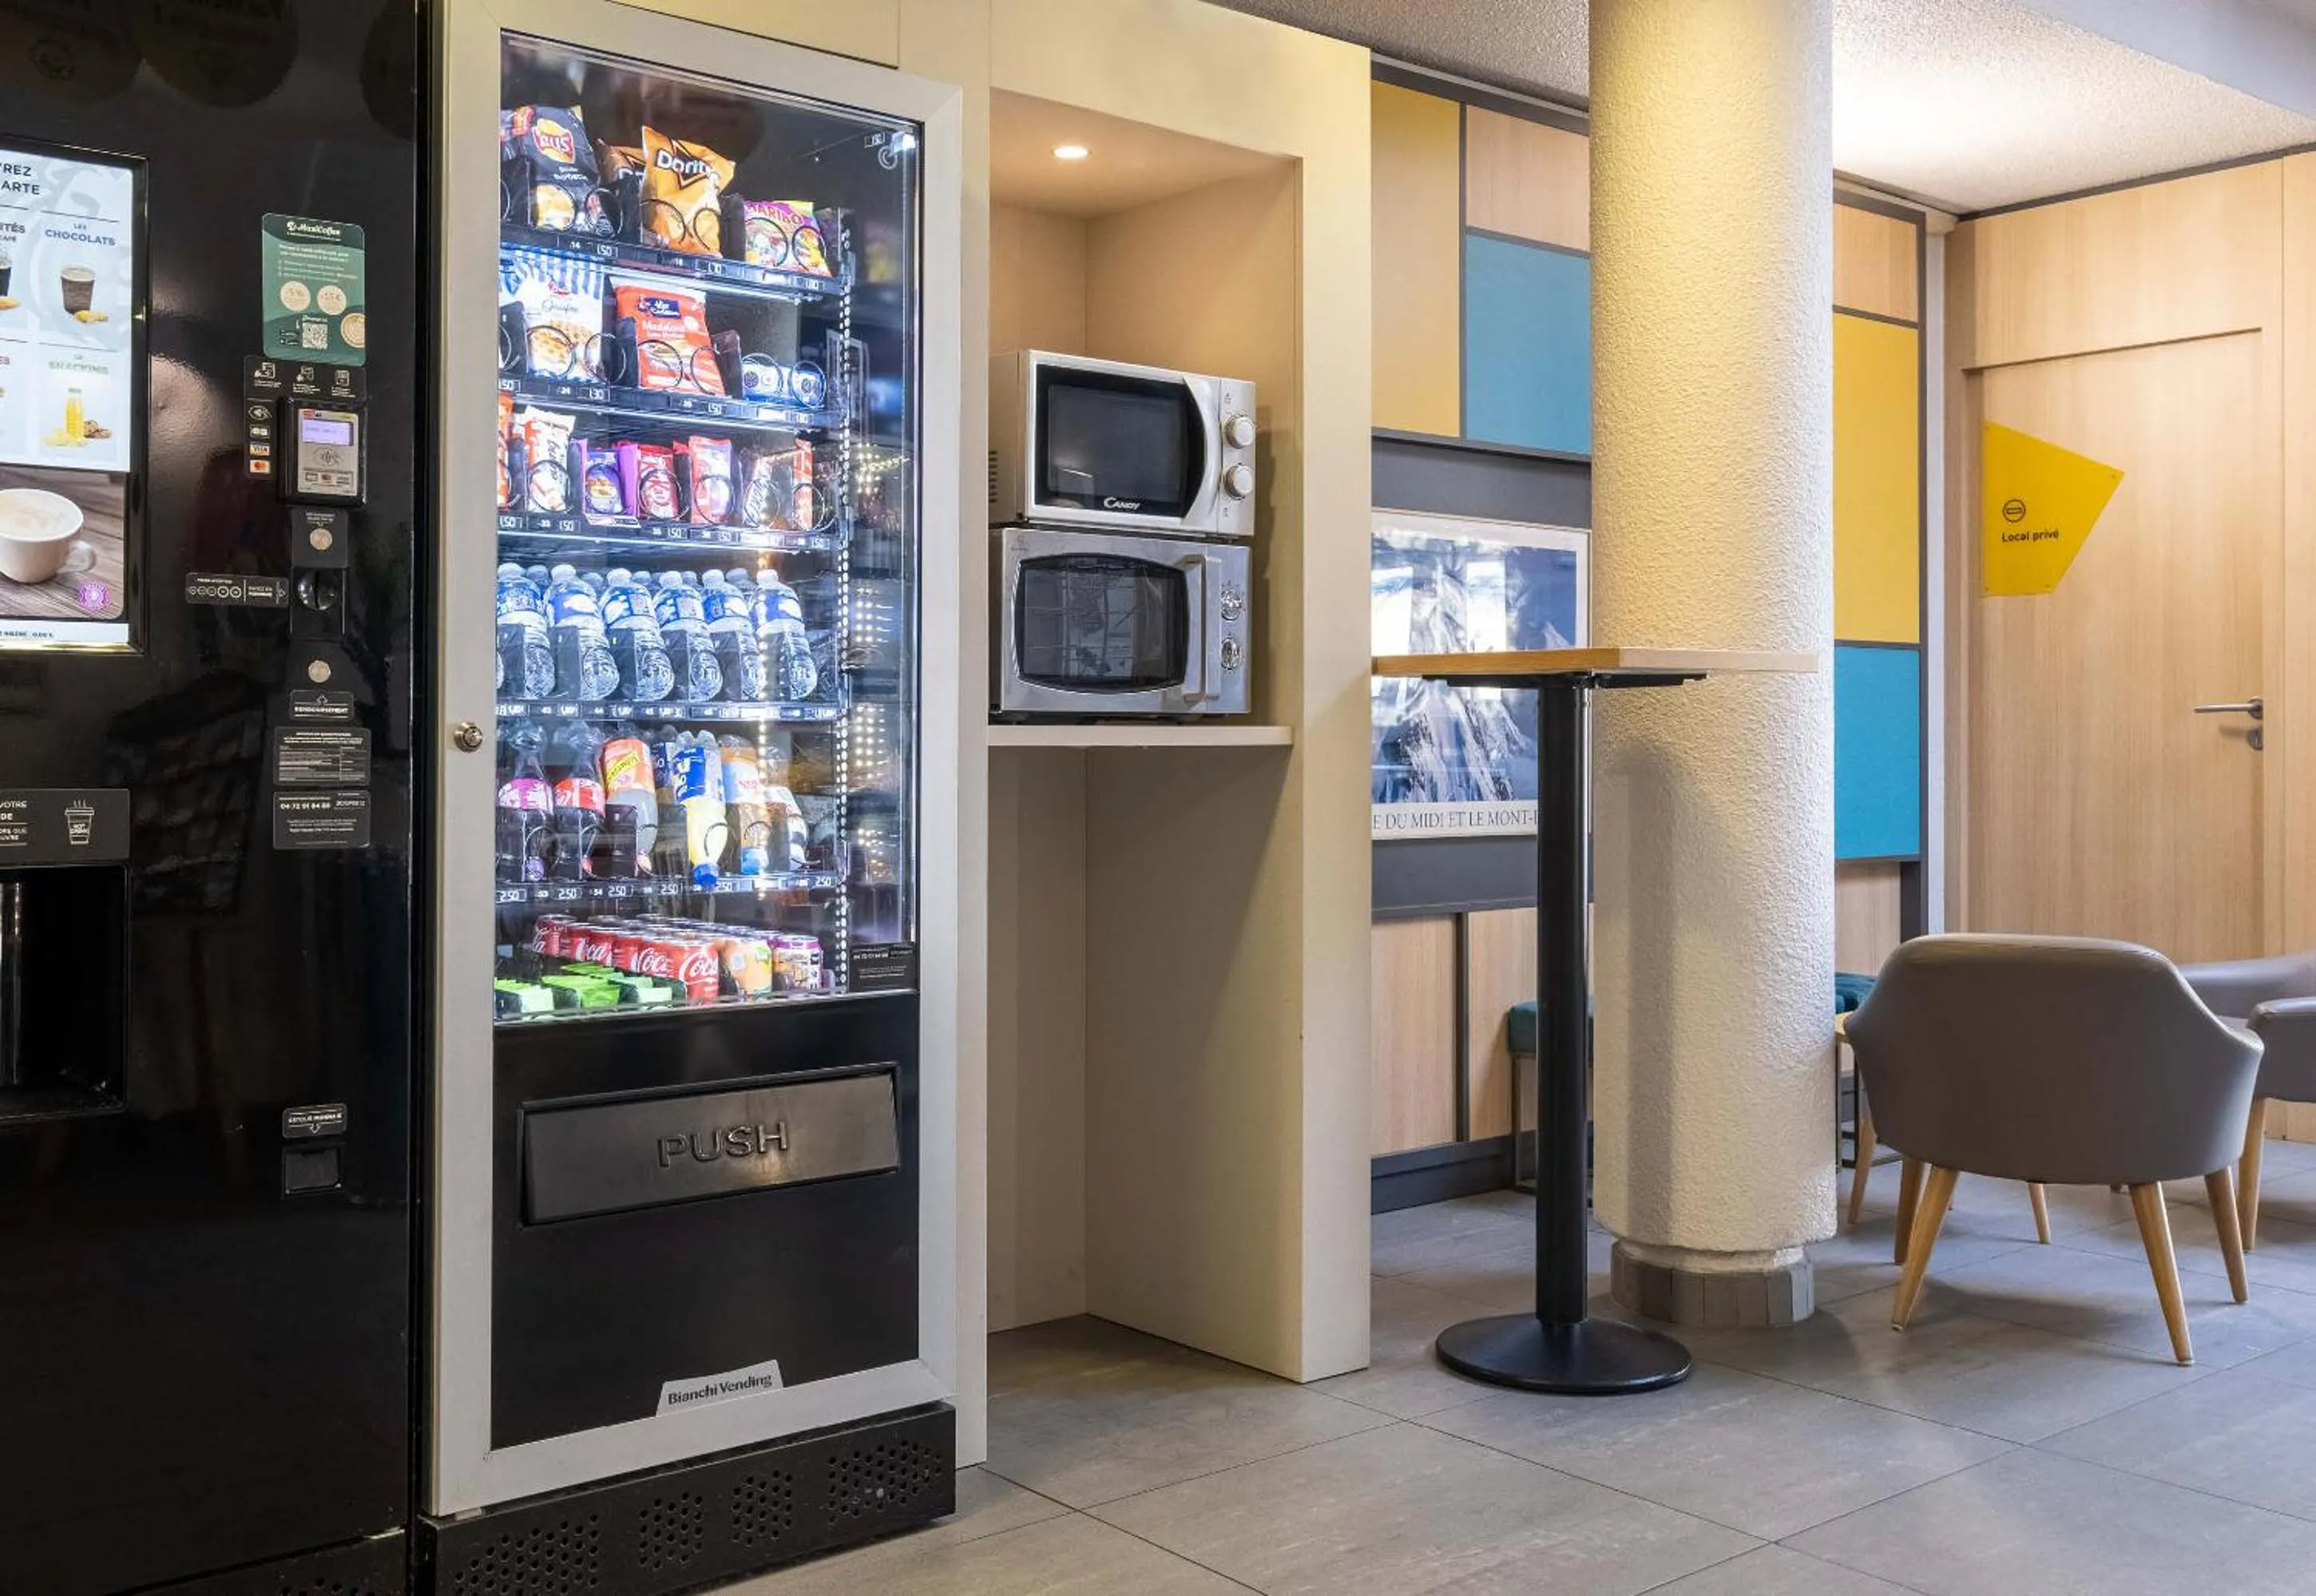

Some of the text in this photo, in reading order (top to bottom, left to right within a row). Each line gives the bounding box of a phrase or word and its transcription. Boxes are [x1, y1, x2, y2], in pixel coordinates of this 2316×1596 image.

[0, 163, 32, 176] REZ
[657, 149, 709, 174] Dorit
[45, 229, 116, 246] CHOCOLATS
[2001, 531, 2029, 543] Local
[1386, 814, 1406, 830] DU
[1412, 813, 1444, 828] MIDI
[1449, 811, 1466, 827] ET
[1469, 811, 1484, 827] LE
[1488, 810, 1537, 826] MONT-
[657, 1121, 788, 1168] PUSH
[668, 1375, 773, 1405] Bianchi Vending
